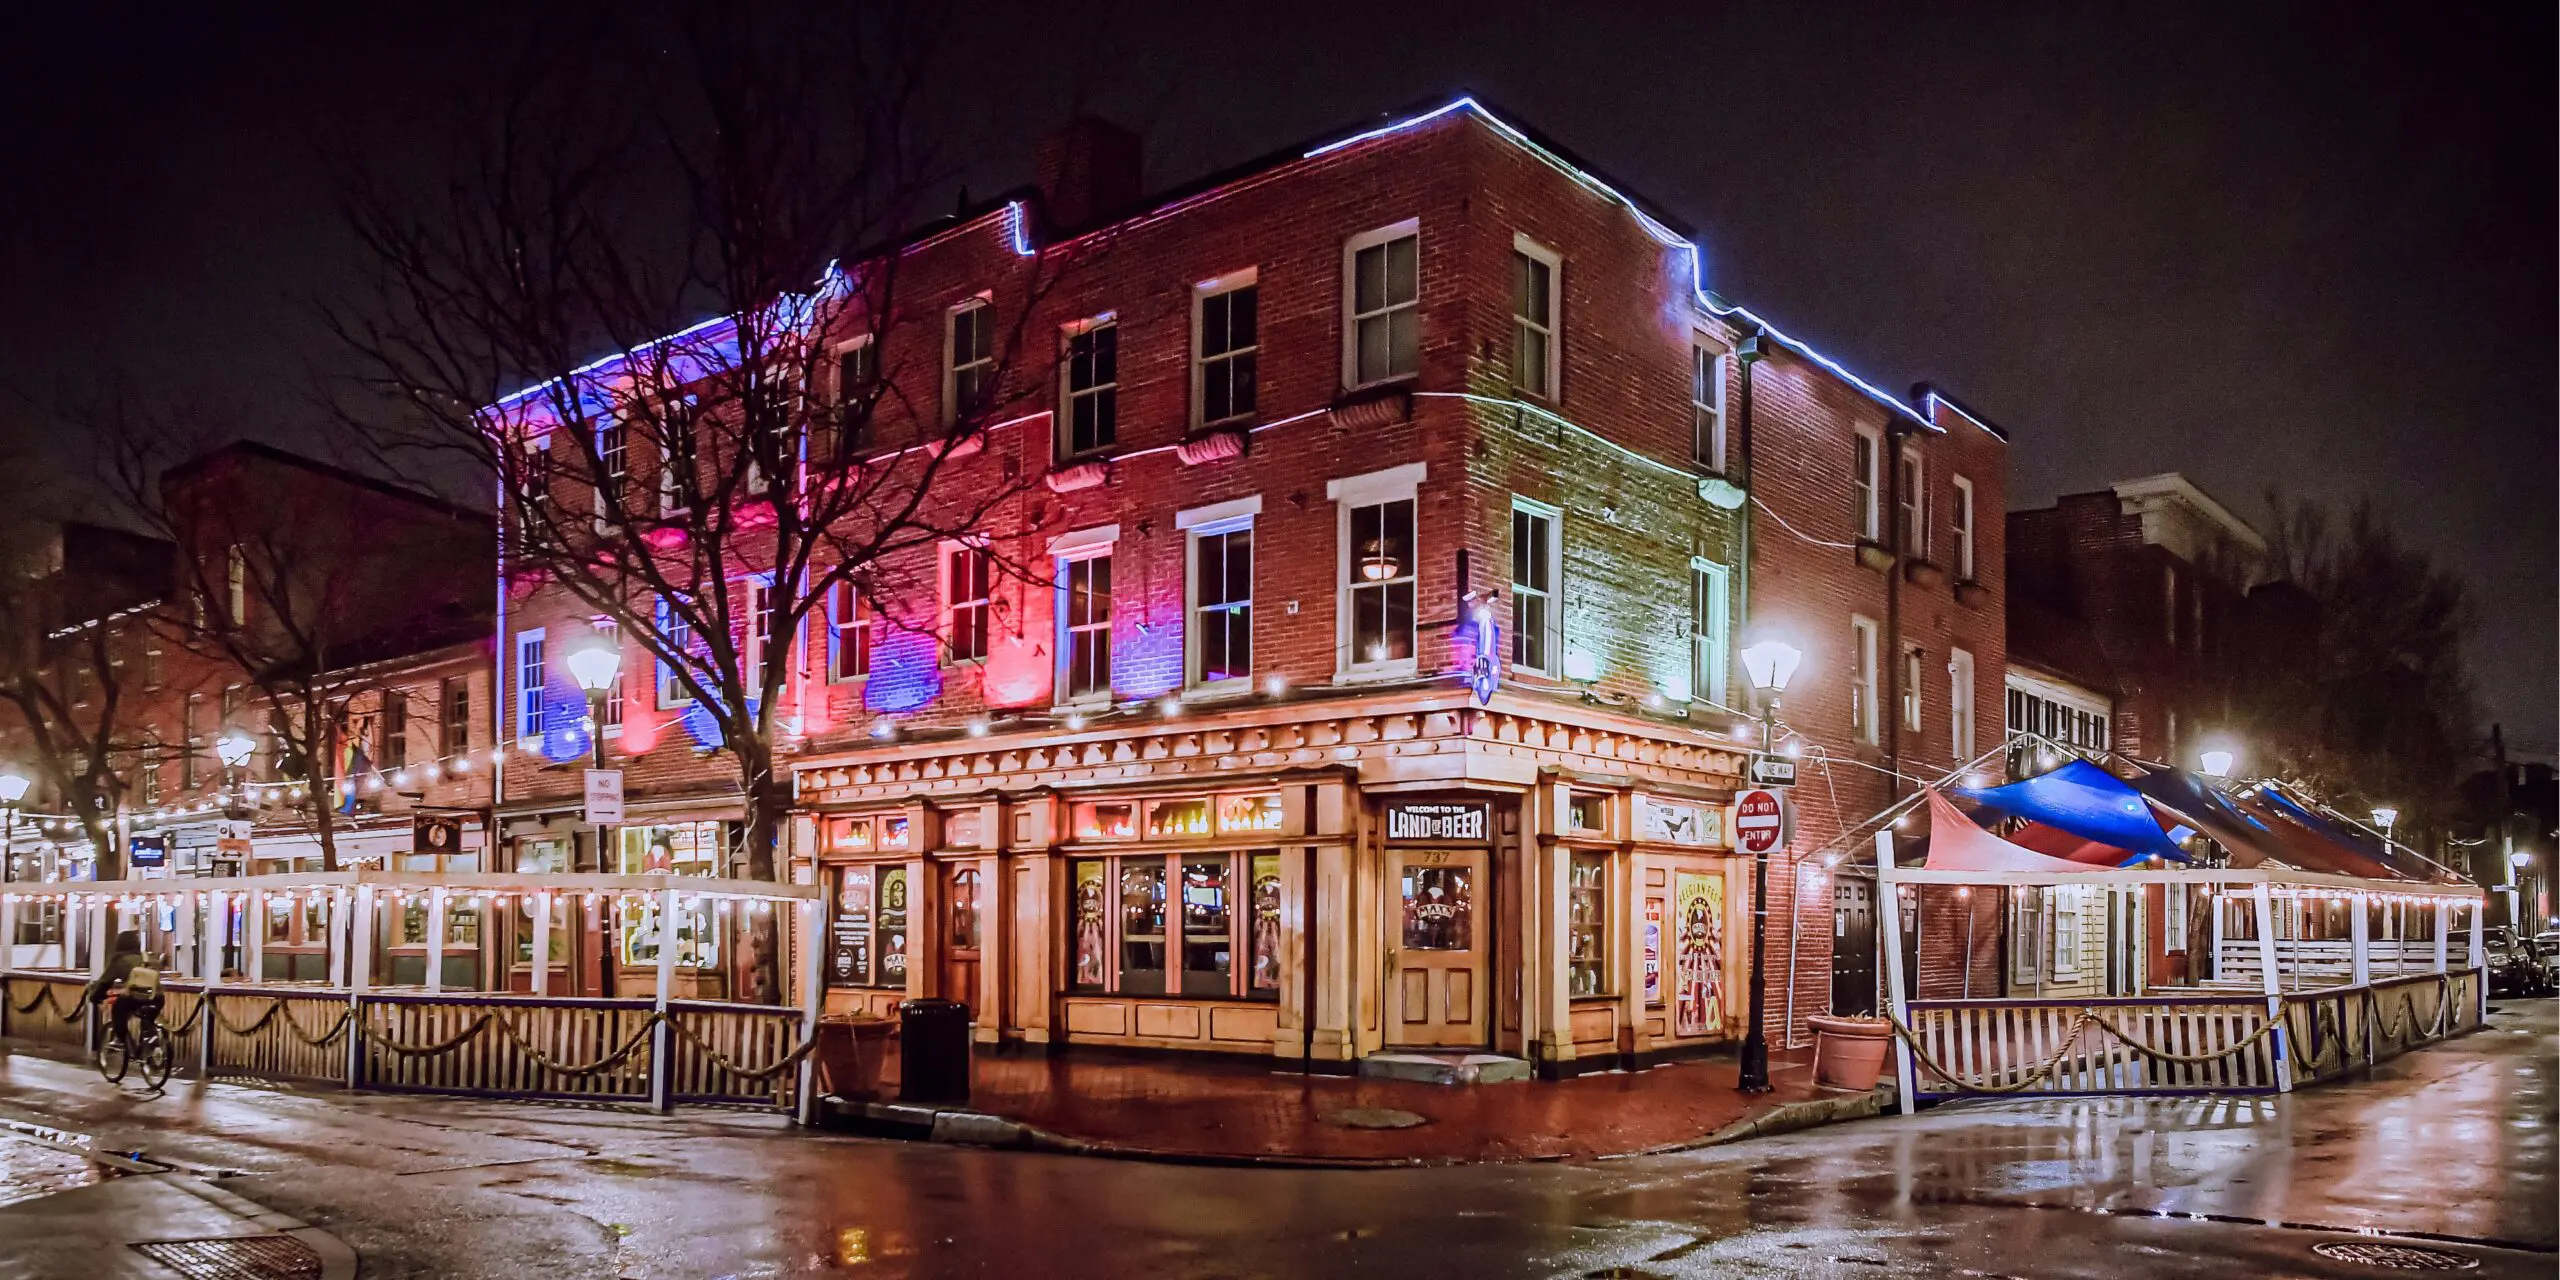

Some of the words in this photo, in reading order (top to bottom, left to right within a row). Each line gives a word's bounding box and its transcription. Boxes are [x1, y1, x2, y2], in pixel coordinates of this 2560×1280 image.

[1763, 763, 1776, 776] ONE
[1777, 764, 1792, 775] WAY
[598, 779, 611, 788] NO
[1404, 805, 1440, 814] WELCOME
[1440, 805, 1452, 814] TO
[1452, 806, 1466, 814] THE
[1742, 803, 1754, 814] DO
[1757, 802, 1775, 813] NOT
[1389, 808, 1431, 838] LAND
[1431, 820, 1442, 834] OF
[1442, 810, 1483, 839] BEER
[1423, 851, 1451, 863] 737
[1678, 883, 1706, 905] BELGIAN
